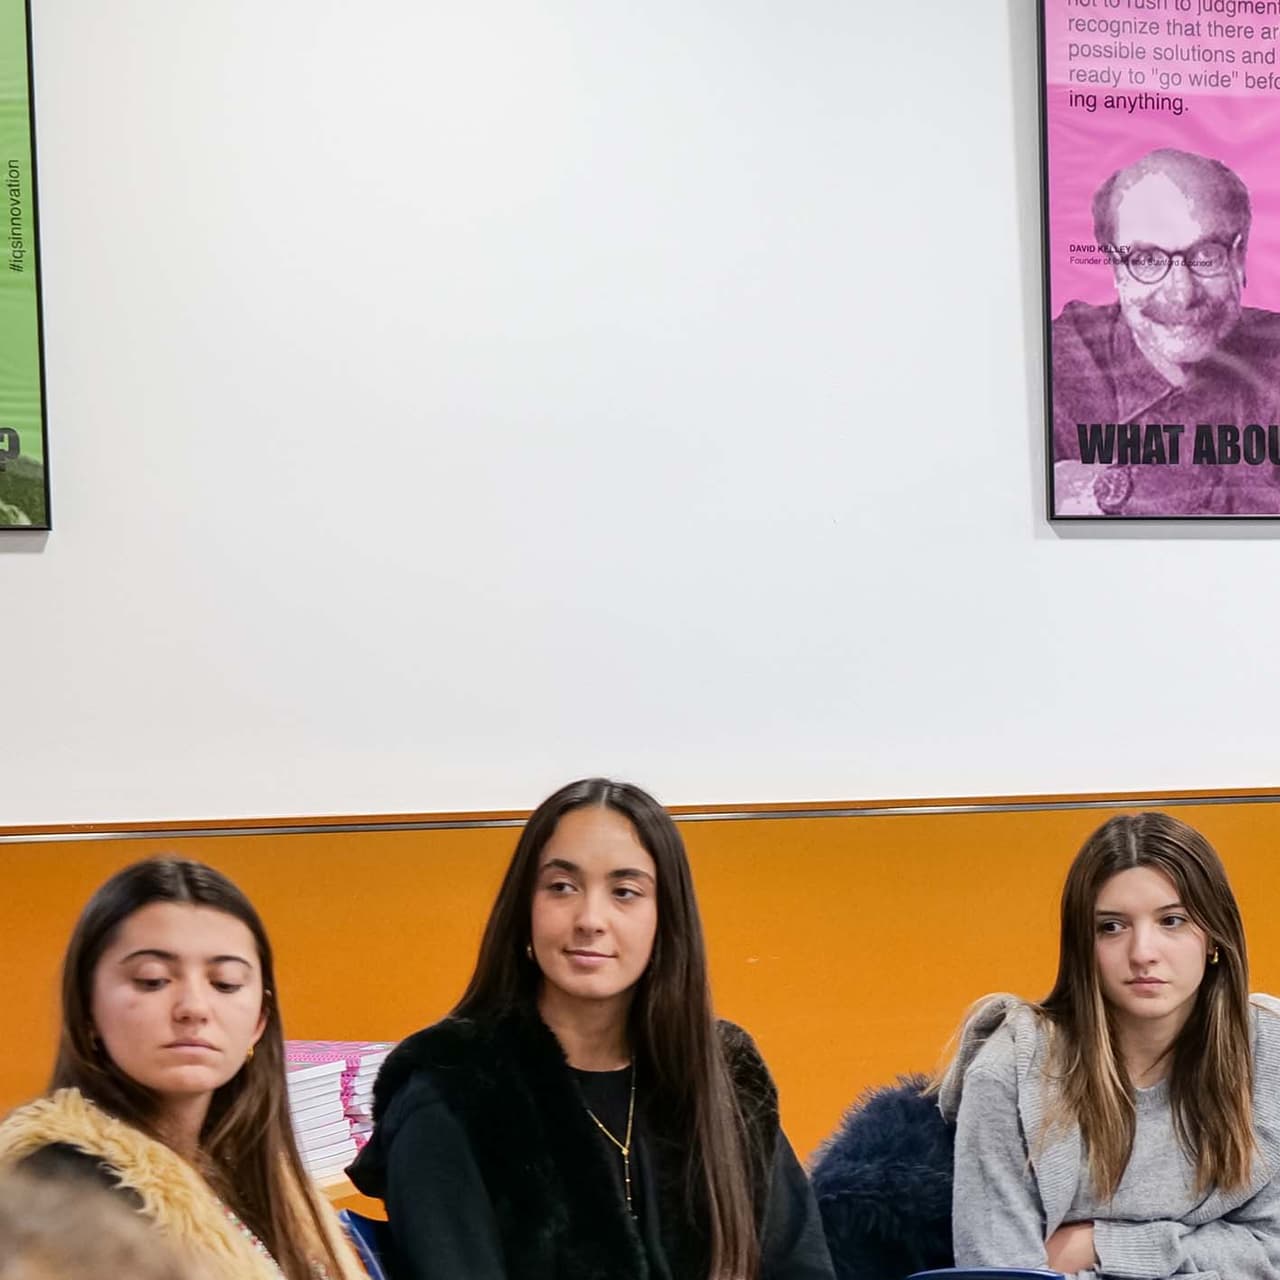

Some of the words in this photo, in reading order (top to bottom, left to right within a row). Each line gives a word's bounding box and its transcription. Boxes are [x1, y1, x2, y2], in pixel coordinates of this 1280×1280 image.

[1068, 17, 1159, 38] recognize
[1167, 19, 1201, 37] that
[1207, 20, 1254, 39] there
[1068, 41, 1146, 64] possible
[1153, 44, 1235, 64] solutions
[1241, 47, 1275, 65] and
[1068, 66, 1121, 87] ready
[1128, 69, 1145, 85] to
[1152, 69, 1182, 90] "go
[1188, 70, 1238, 88] wide"
[1069, 90, 1097, 112] ing
[1104, 93, 1189, 115] anything.
[9, 159, 26, 272] #iqsinnovation
[1069, 244, 1095, 253] DAVID
[1097, 245, 1131, 254] KELLEY
[1069, 256, 1101, 265] Founder
[1077, 424, 1184, 466] WHAT
